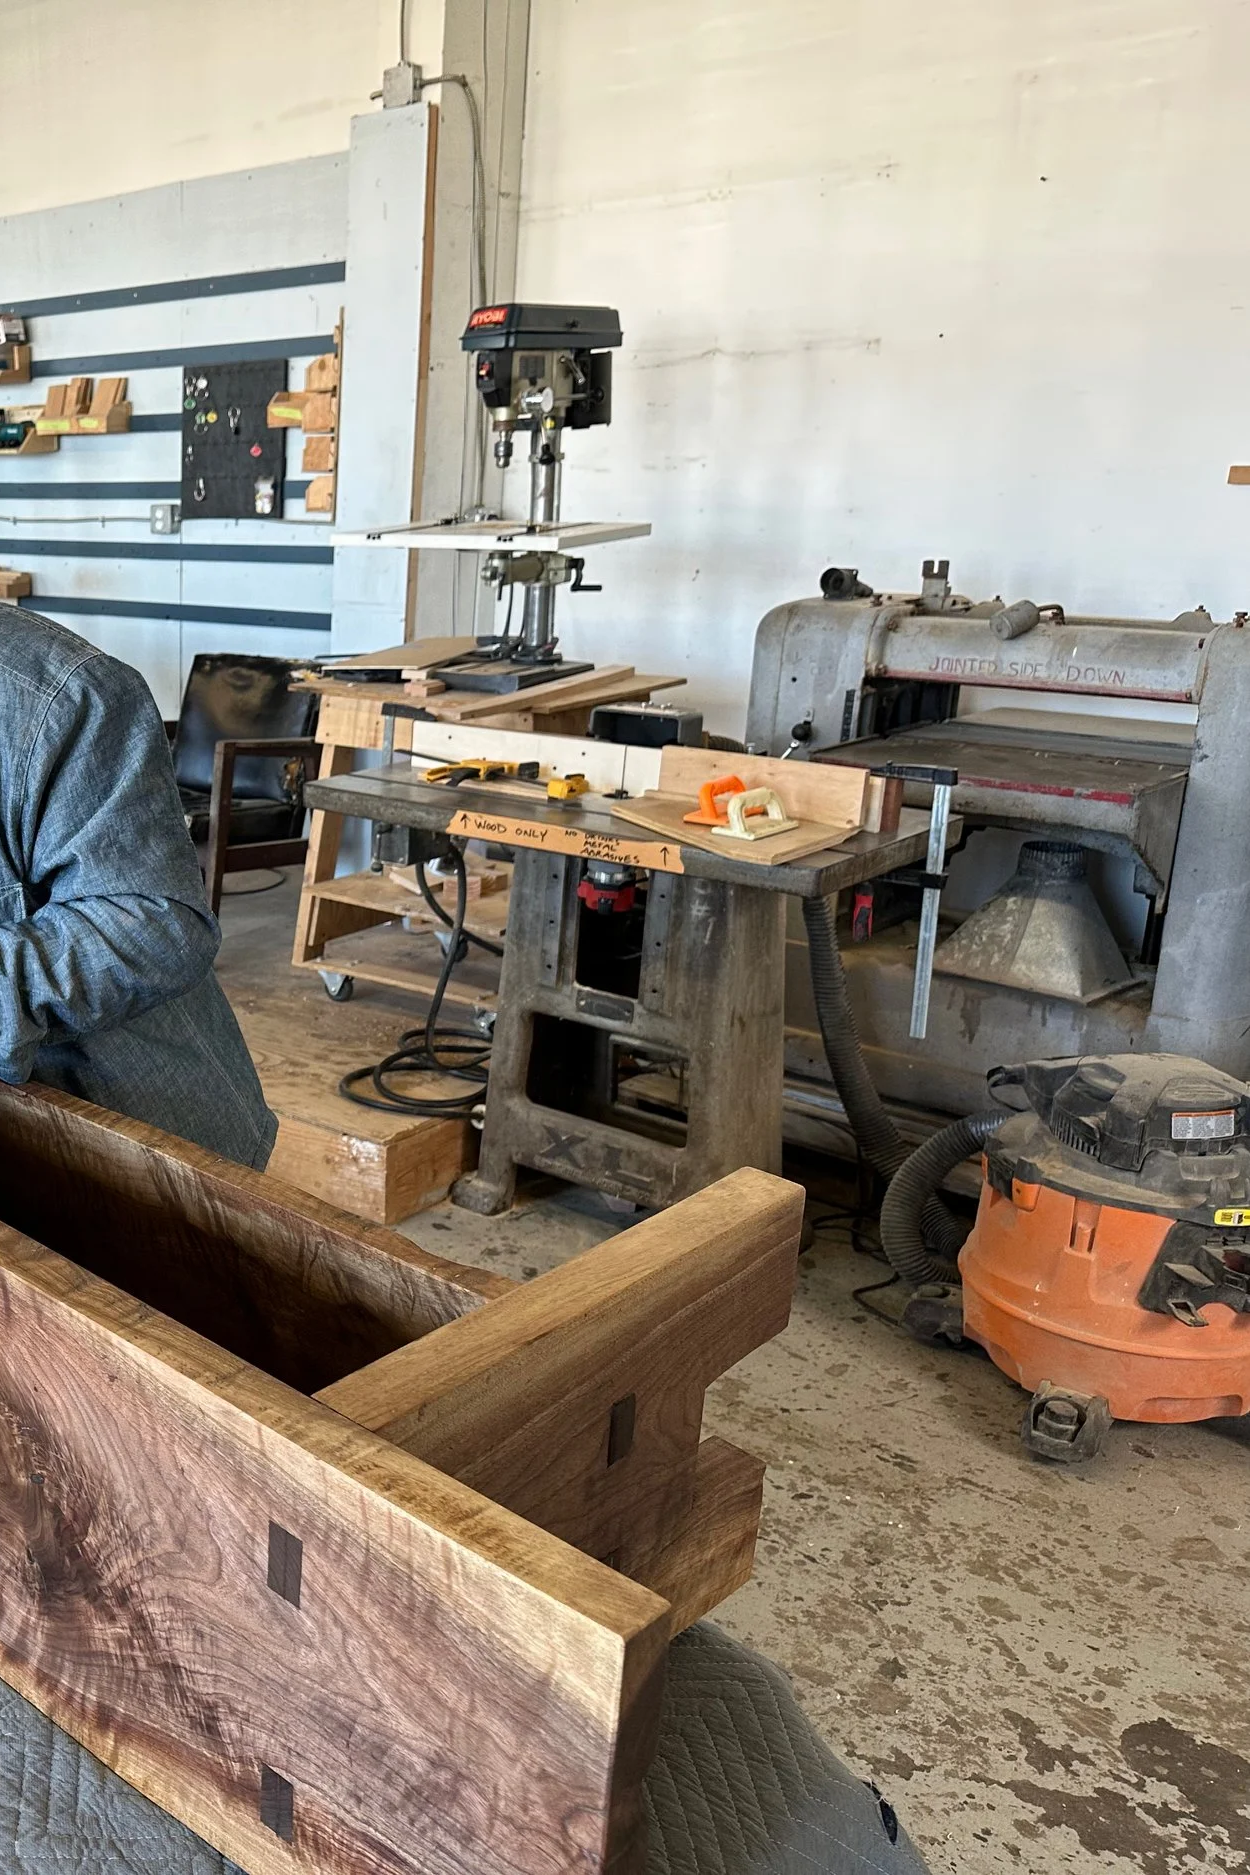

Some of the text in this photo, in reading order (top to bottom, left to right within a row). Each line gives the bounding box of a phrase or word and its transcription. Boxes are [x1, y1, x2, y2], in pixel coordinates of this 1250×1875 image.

[1009, 661, 1044, 678] SIDE
[1067, 665, 1126, 687] DOWN
[474, 819, 507, 834] WOOD
[515, 827, 548, 842] ONLY
[583, 840, 617, 852] METAL
